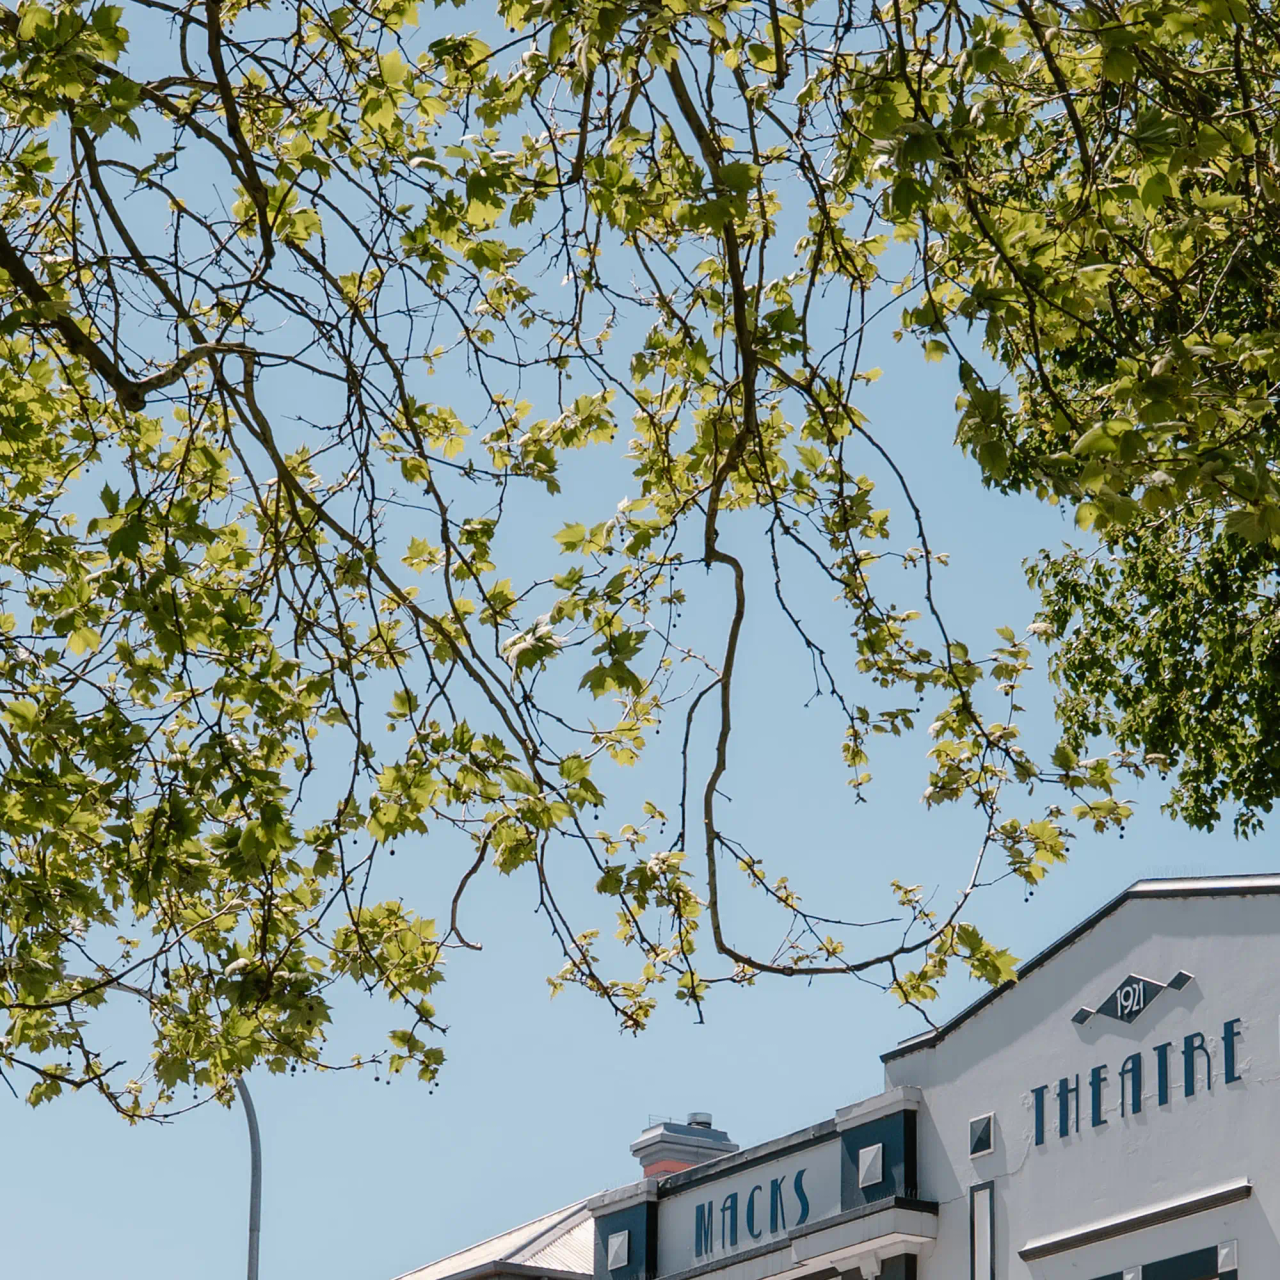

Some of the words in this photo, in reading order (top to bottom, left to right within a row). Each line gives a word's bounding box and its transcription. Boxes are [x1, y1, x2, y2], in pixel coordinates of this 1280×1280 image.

[1116, 982, 1145, 1016] 1921
[1030, 1018, 1243, 1146] THEATRE
[695, 1168, 810, 1258] MACKS
